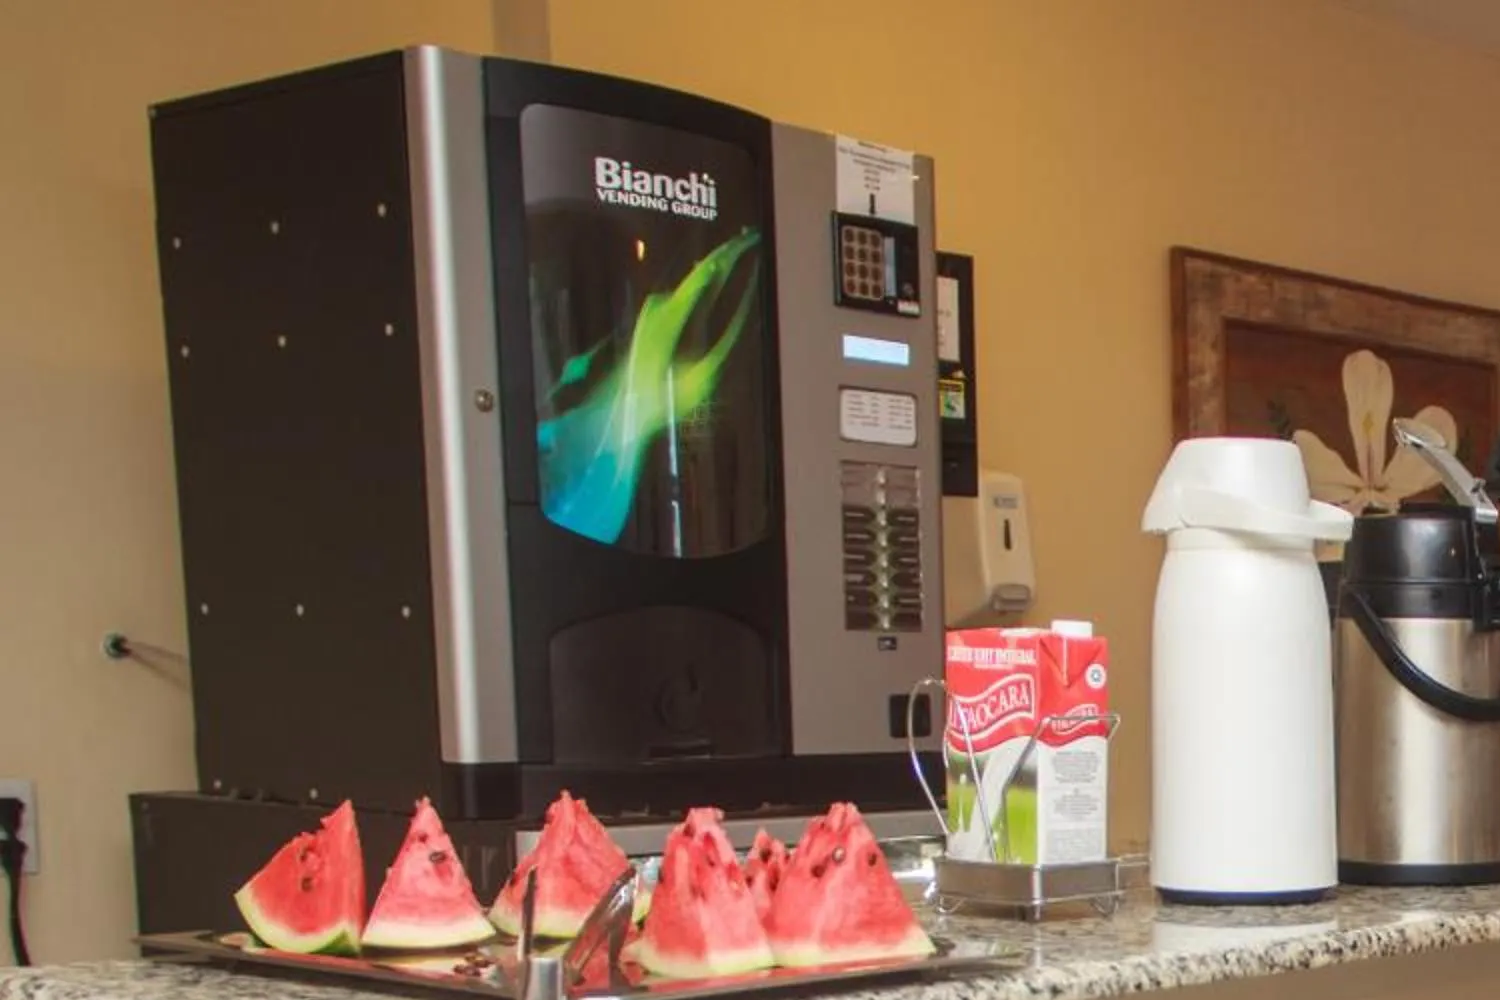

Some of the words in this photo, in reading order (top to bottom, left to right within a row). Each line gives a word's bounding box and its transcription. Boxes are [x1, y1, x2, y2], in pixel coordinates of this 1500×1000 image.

[595, 156, 717, 207] Bianchi
[596, 188, 669, 212] VENDING
[671, 200, 718, 220] GROUP
